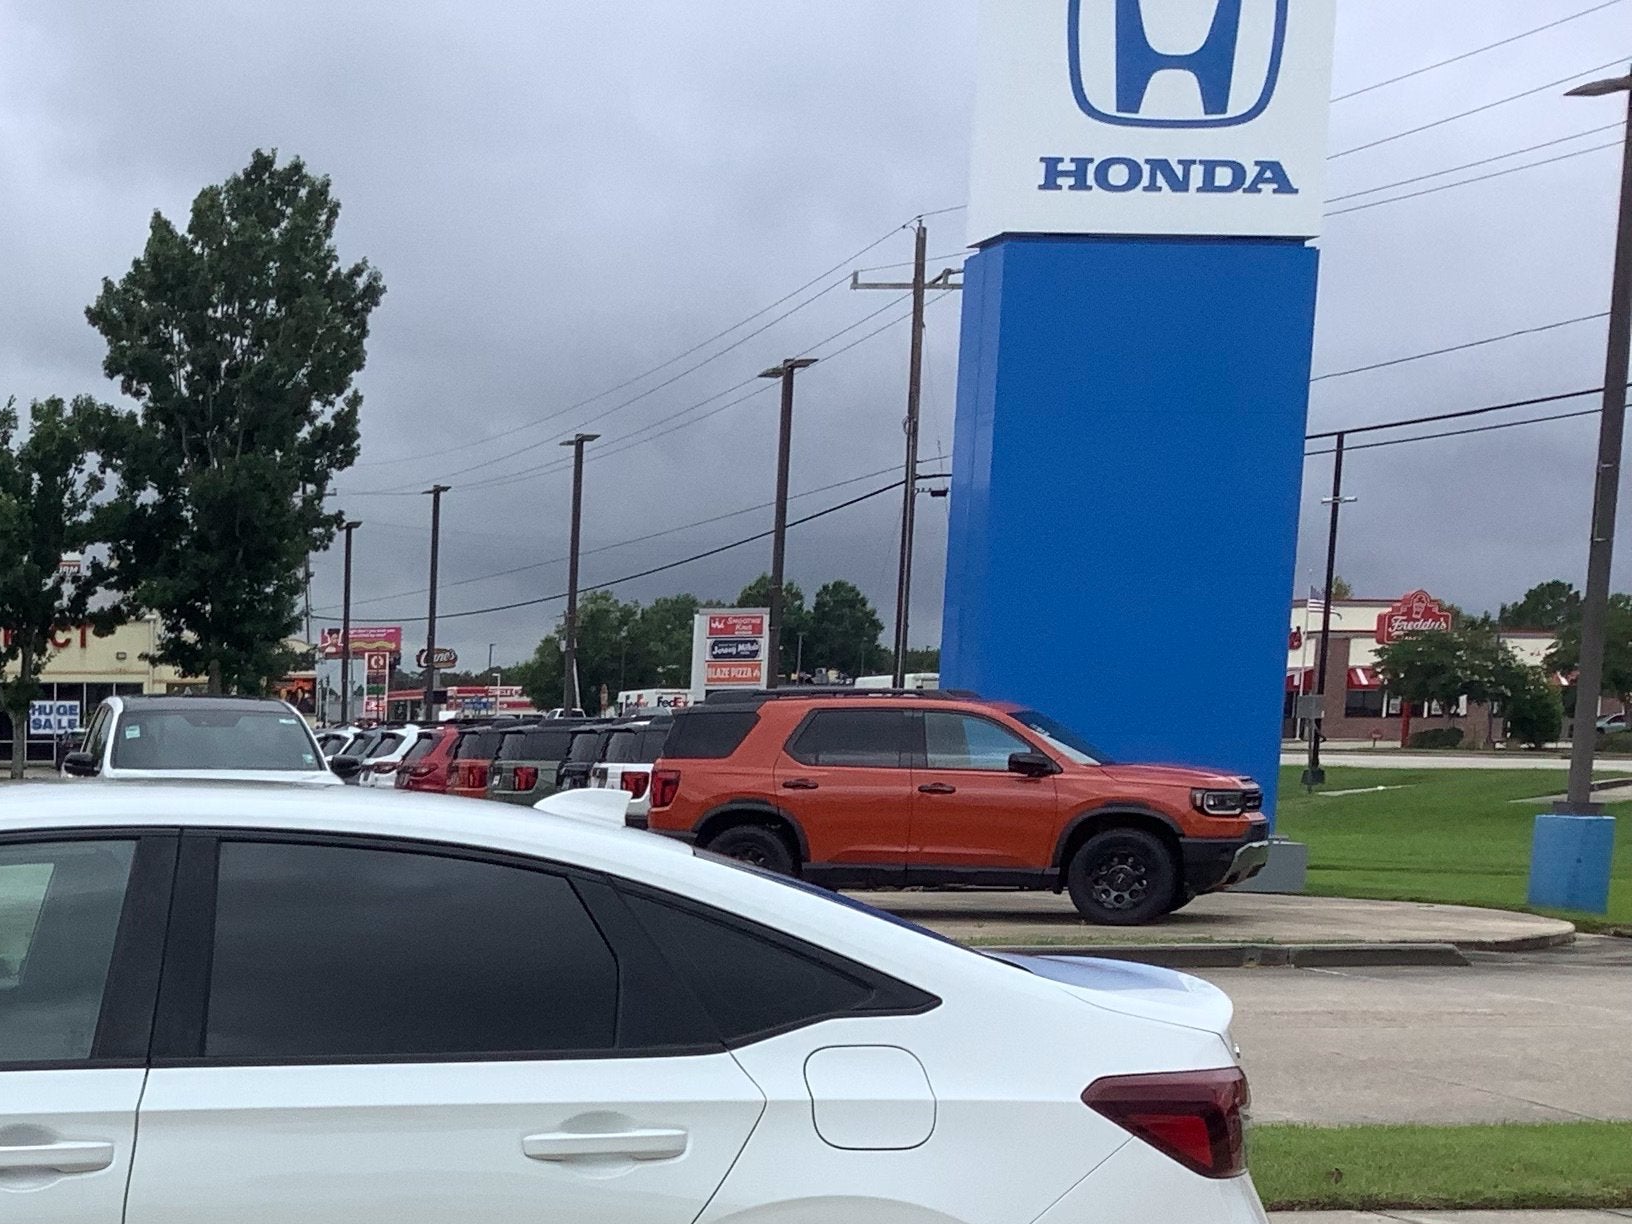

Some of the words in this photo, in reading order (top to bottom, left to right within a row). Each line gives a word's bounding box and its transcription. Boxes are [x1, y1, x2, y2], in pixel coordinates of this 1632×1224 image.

[1038, 157, 1299, 194] HONDA
[1388, 615, 1447, 632] Freddy's
[709, 667, 729, 678] BLAZE
[731, 667, 752, 678] PIZZA
[657, 696, 689, 708] FedEx
[32, 704, 78, 716] HUGE
[32, 718, 77, 730] SALE
